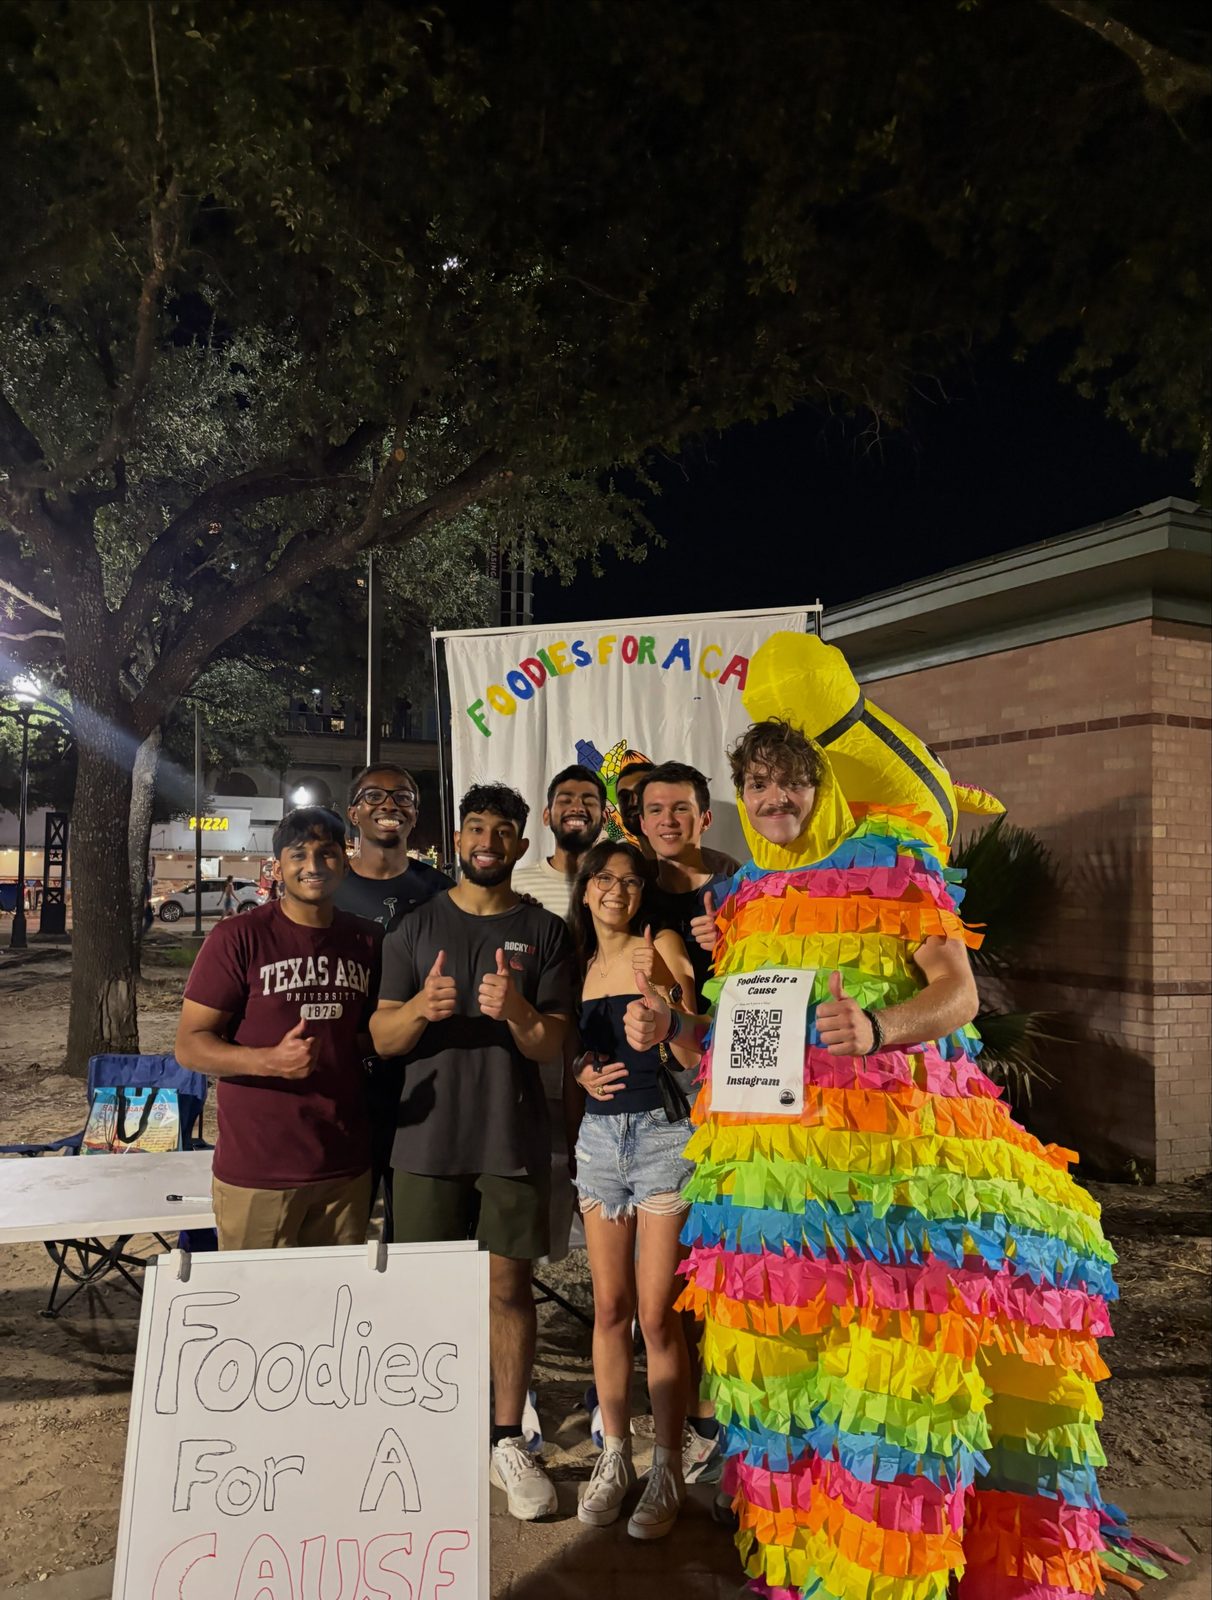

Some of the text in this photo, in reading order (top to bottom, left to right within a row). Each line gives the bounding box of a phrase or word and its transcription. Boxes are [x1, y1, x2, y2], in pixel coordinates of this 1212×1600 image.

[466, 639, 593, 738] FOODIES
[598, 634, 657, 666] FOR
[661, 637, 692, 672] A
[189, 816, 229, 830] PIZZA
[504, 941, 528, 953] ROCKY
[260, 955, 370, 998] TEXAS A&M
[736, 974, 798, 987] Foodies for a
[286, 992, 356, 1002] UNIVERSITY
[747, 986, 777, 995] Cause
[307, 1005, 337, 1018] 1876
[726, 1075, 780, 1087] Instagram
[155, 1284, 459, 1415] Foodies
[172, 1427, 422, 1517] For A
